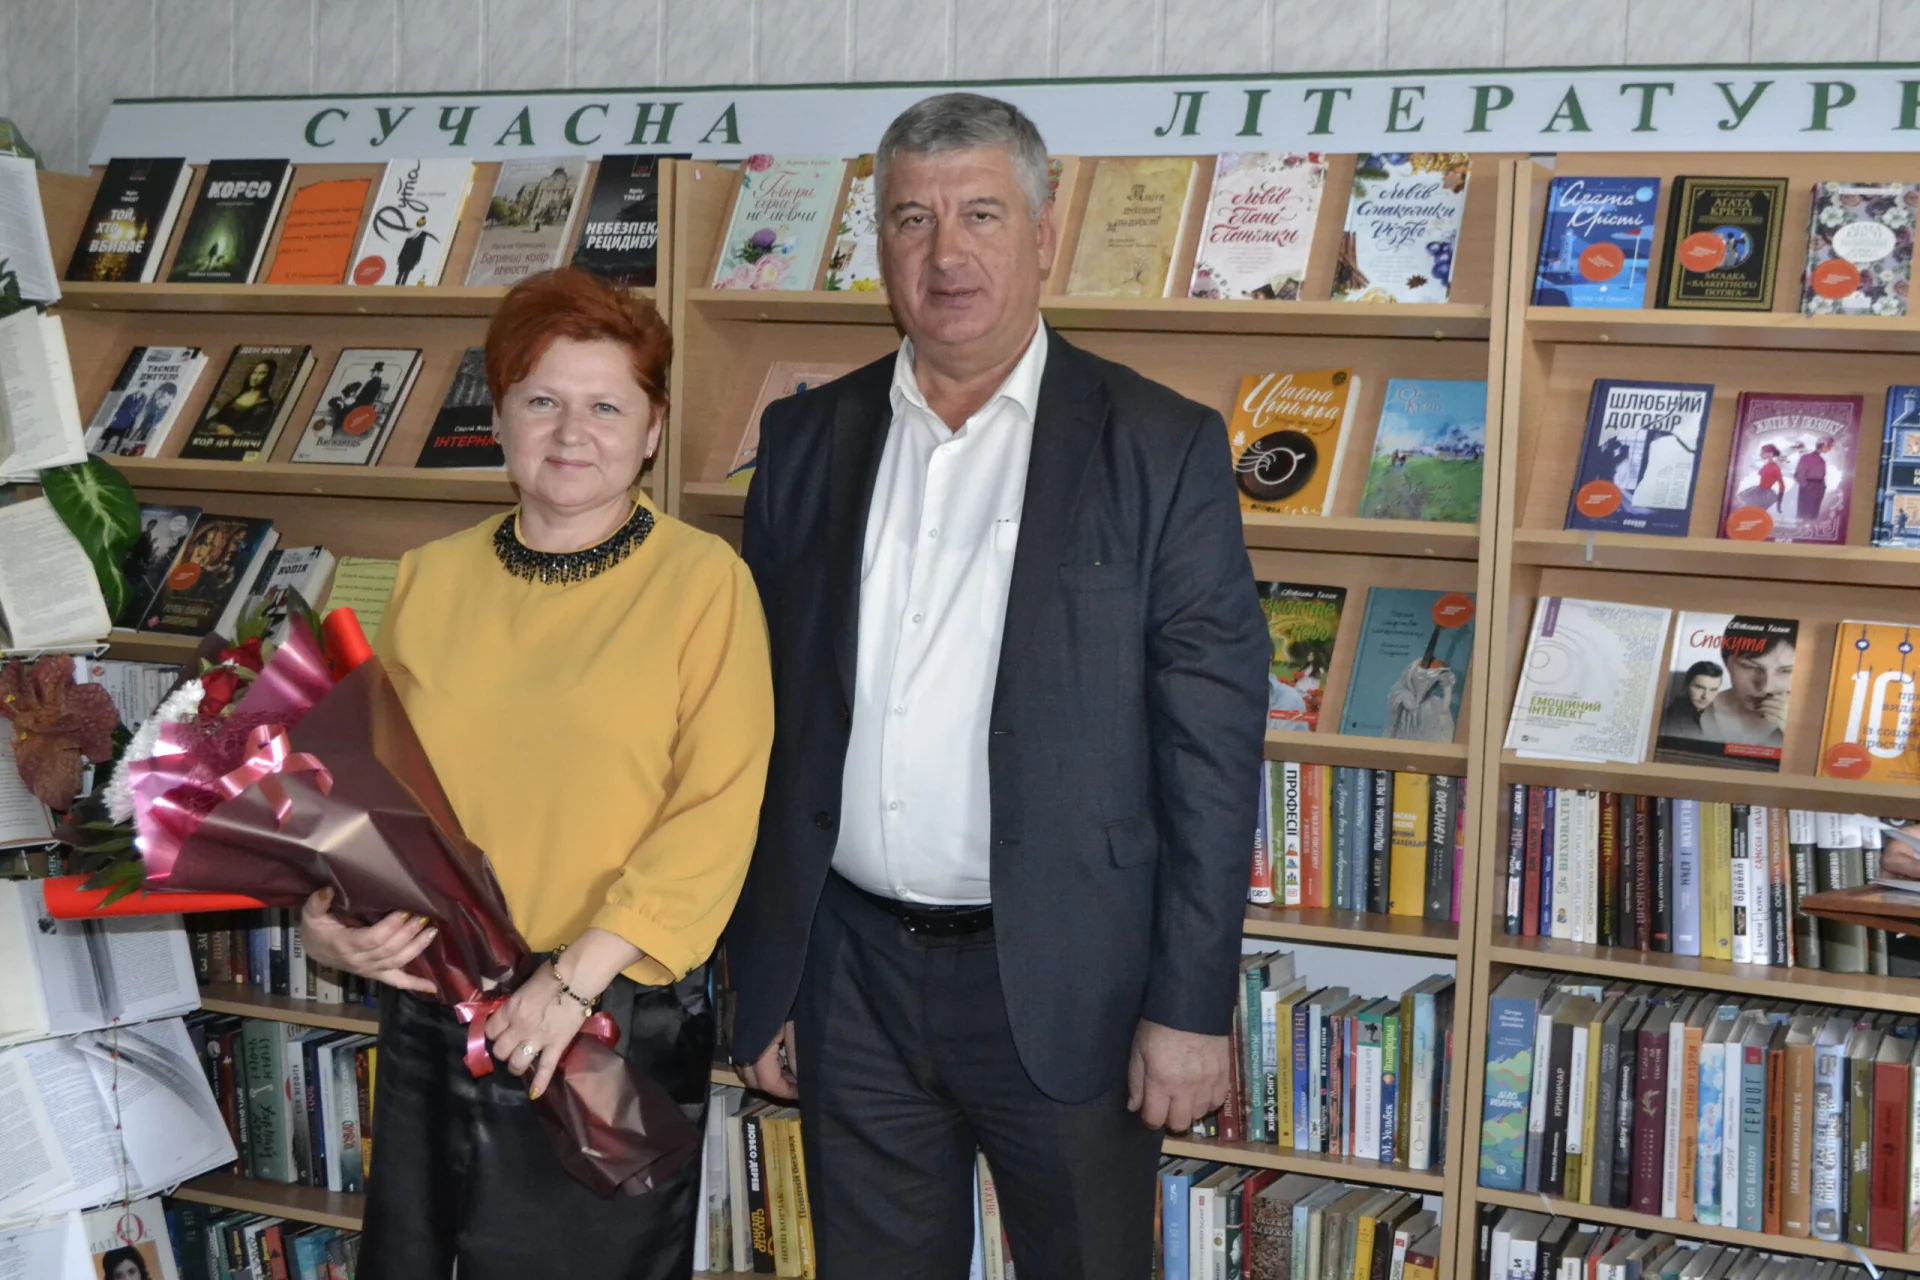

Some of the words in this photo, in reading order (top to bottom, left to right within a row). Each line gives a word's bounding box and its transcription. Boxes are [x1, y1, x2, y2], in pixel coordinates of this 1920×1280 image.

[304, 101, 742, 147] СУЧАСНА
[207, 181, 272, 200] КОРСО
[1559, 180, 1636, 208] Агата
[1713, 198, 1752, 208] АГАТА
[110, 207, 136, 221] ТОЙ,
[1566, 206, 1645, 238] Крісті
[1710, 207, 1753, 217] КРІСТІ
[96, 221, 119, 234] ХТО
[586, 221, 659, 235] НЕБЕЗПЕК
[89, 239, 145, 254] ВБИВАЄ
[586, 235, 658, 251] РЕЦИДИВУ
[1704, 272, 1746, 281] ЗАГАДКА
[1609, 392, 1703, 413] ШЛЮБНИЙ
[1605, 412, 1682, 431] ДОГОВІР
[192, 436, 213, 446] КОД
[233, 438, 262, 448] ВІНЧІ
[433, 435, 496, 449] ІНТЕРНА
[1690, 629, 1768, 658] Спокута
[1527, 706, 1586, 720] ІНТЕЛЕКТ
[1530, 695, 1602, 713] ЕМОЦІЙНИЙ
[1845, 670, 1915, 759] 10
[1376, 778, 1387, 795] МЕНЕ
[1286, 769, 1299, 837] ПРОФЕСІЇ
[1375, 795, 1386, 806] НА
[1433, 790, 1448, 845] ОКСАНЕН
[1559, 797, 1571, 871] ВИХОВАТИ
[1636, 813, 1645, 861] КОРСУНЬ
[1680, 861, 1692, 886] КРИМ
[1636, 862, 1646, 924] КОЗАЦЬКИЙ
[1294, 1013, 1306, 1039] ТІНІ
[1383, 1024, 1398, 1072] Платформа
[1265, 1072, 1275, 1096] СНІГУ
[1553, 1067, 1565, 1117] КРИНИЧАР
[1267, 1105, 1276, 1132] ЖІНКА
[1743, 1077, 1762, 1135] ГЕРЦОГ
[1382, 1103, 1395, 1141] Уельбек
[1382, 1142, 1393, 1156] М.
[749, 1159, 760, 1192] ДЕРЕШ
[984, 1180, 996, 1217] ЗНАХАР
[776, 1191, 786, 1232] КОРЧАК
[1253, 1226, 1293, 1237] ЗАБУЖКО
[779, 1233, 789, 1264] ЯНУШ
